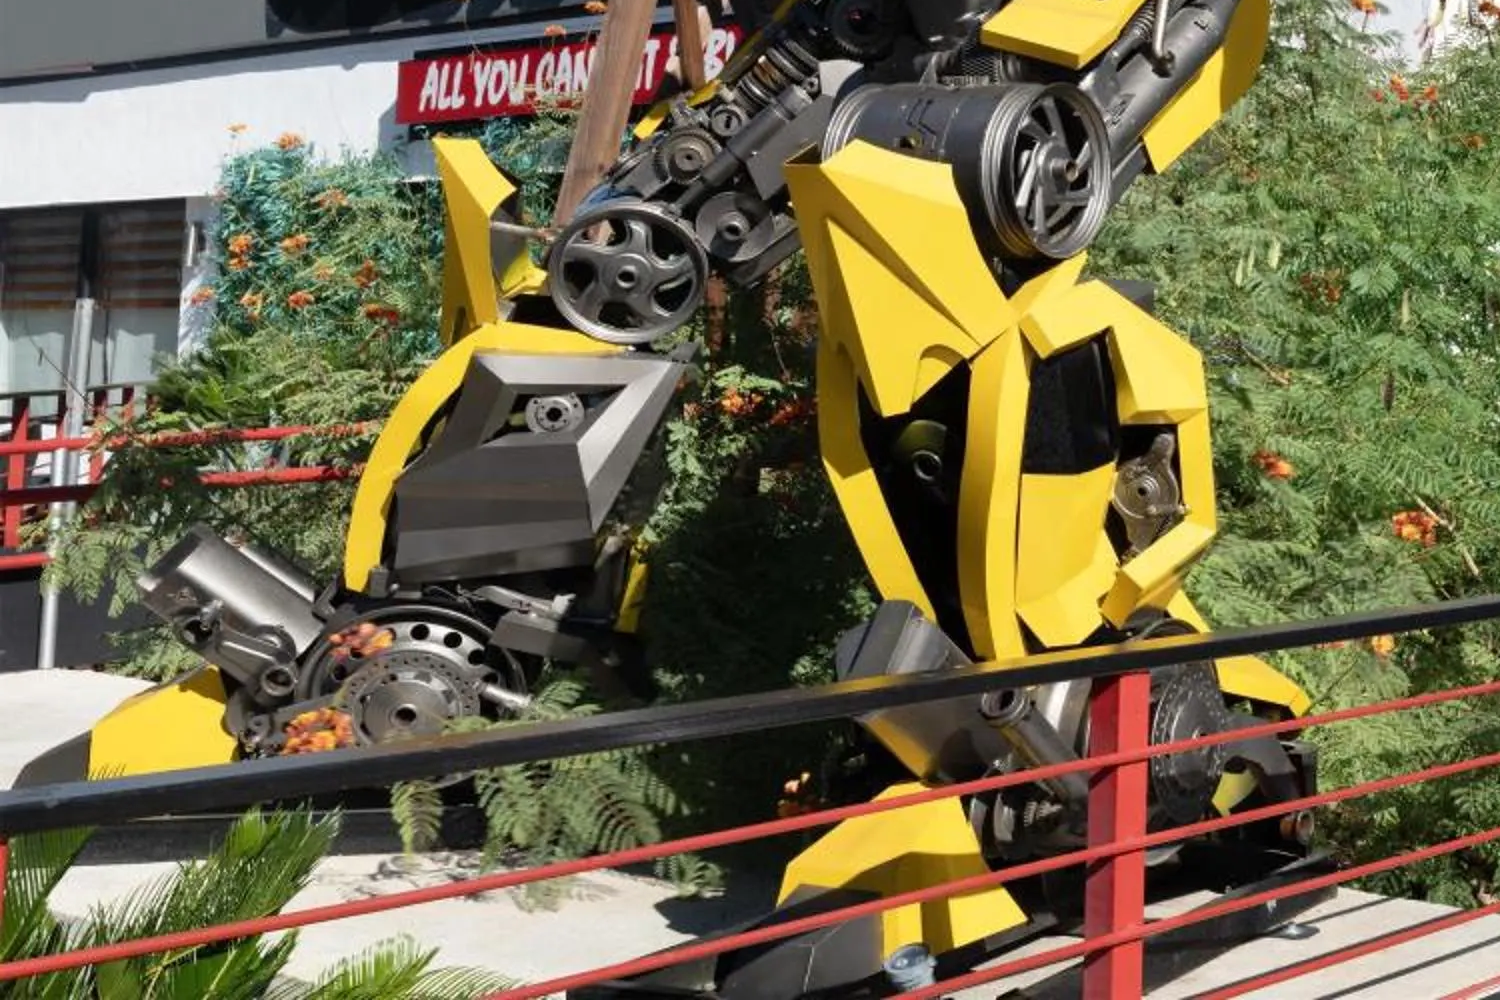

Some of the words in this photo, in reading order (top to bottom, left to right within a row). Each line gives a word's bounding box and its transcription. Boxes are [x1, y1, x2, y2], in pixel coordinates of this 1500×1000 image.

[418, 60, 465, 112] ALL
[472, 53, 530, 107] YOU
[535, 46, 598, 98] CAN
